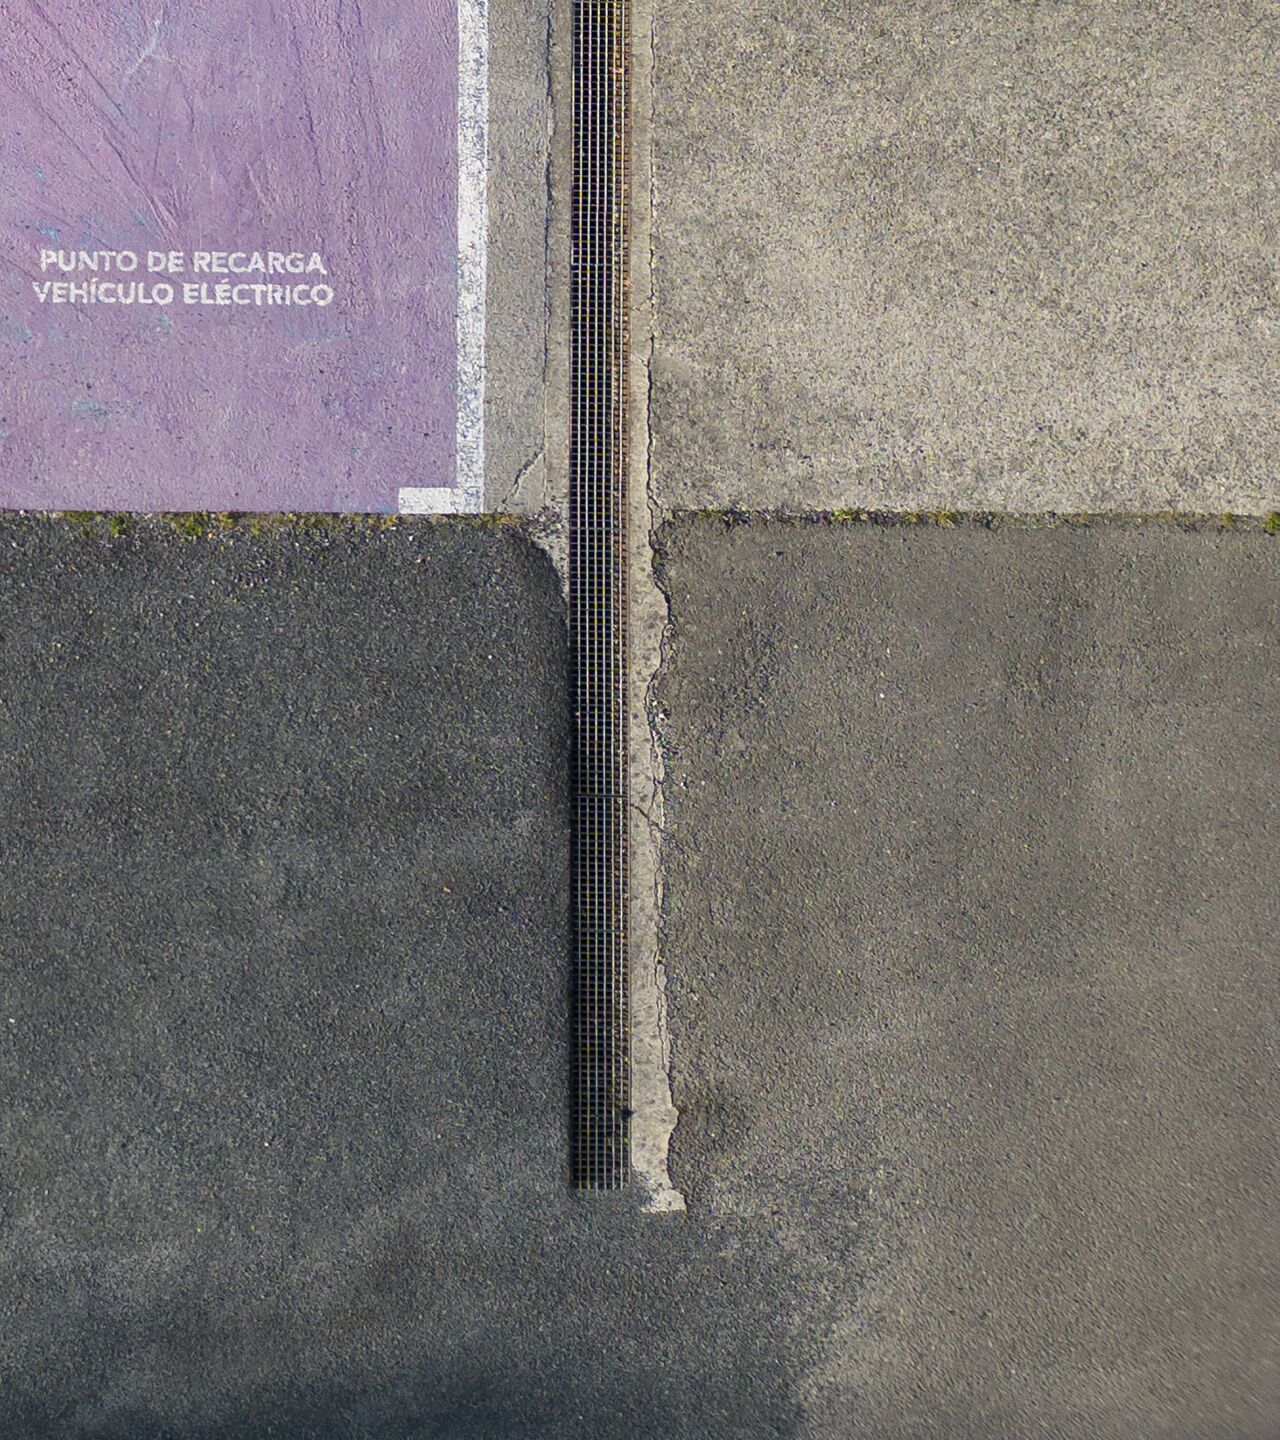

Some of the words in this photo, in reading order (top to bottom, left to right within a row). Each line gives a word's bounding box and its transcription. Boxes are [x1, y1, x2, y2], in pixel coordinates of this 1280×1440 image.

[39, 249, 138, 274] PUNTO
[146, 251, 184, 274] DE
[192, 251, 328, 276] RECARGA
[31, 277, 175, 306] VEHÍCULO
[182, 277, 335, 308] ELÉCTRICO
